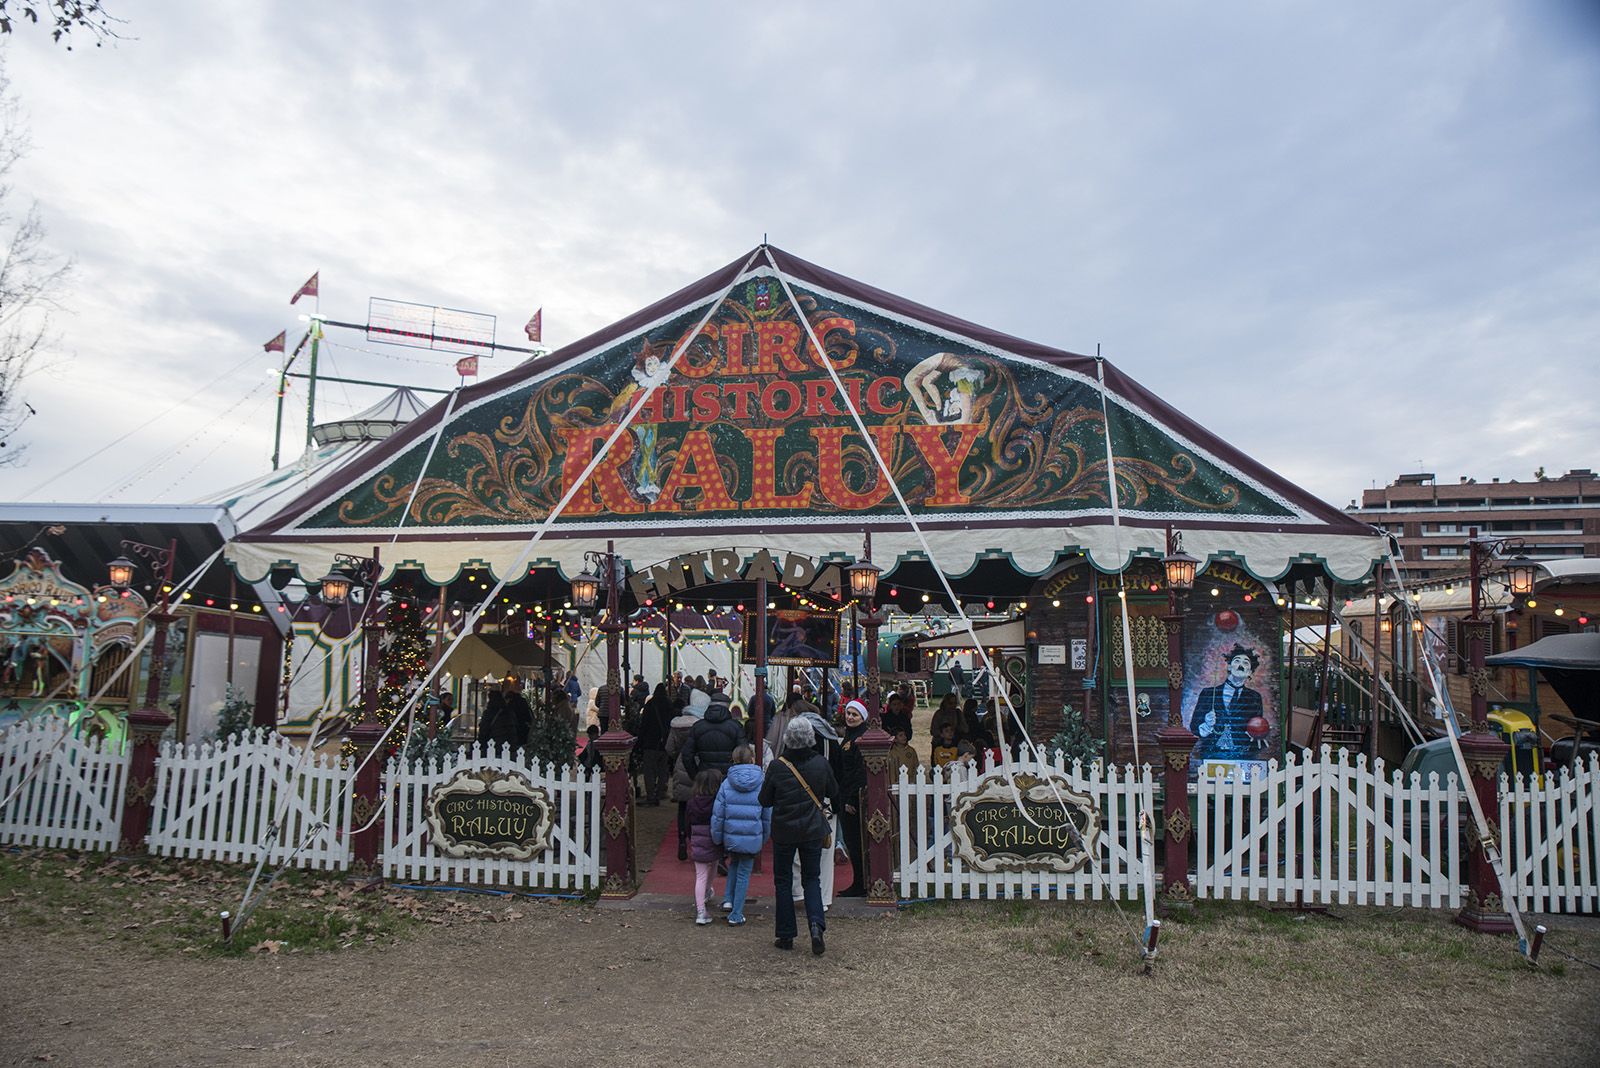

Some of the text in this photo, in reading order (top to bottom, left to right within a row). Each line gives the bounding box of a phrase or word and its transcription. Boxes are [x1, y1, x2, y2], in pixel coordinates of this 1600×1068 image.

[671, 317, 858, 378] CIRC
[550, 422, 986, 517] RALUY
[628, 549, 843, 605] ENTRADA
[446, 799, 474, 814] CIRC
[975, 805, 1078, 824] CIRC HSTÒRIC
[451, 815, 527, 839] RALUY
[982, 824, 1069, 849] RALUY
